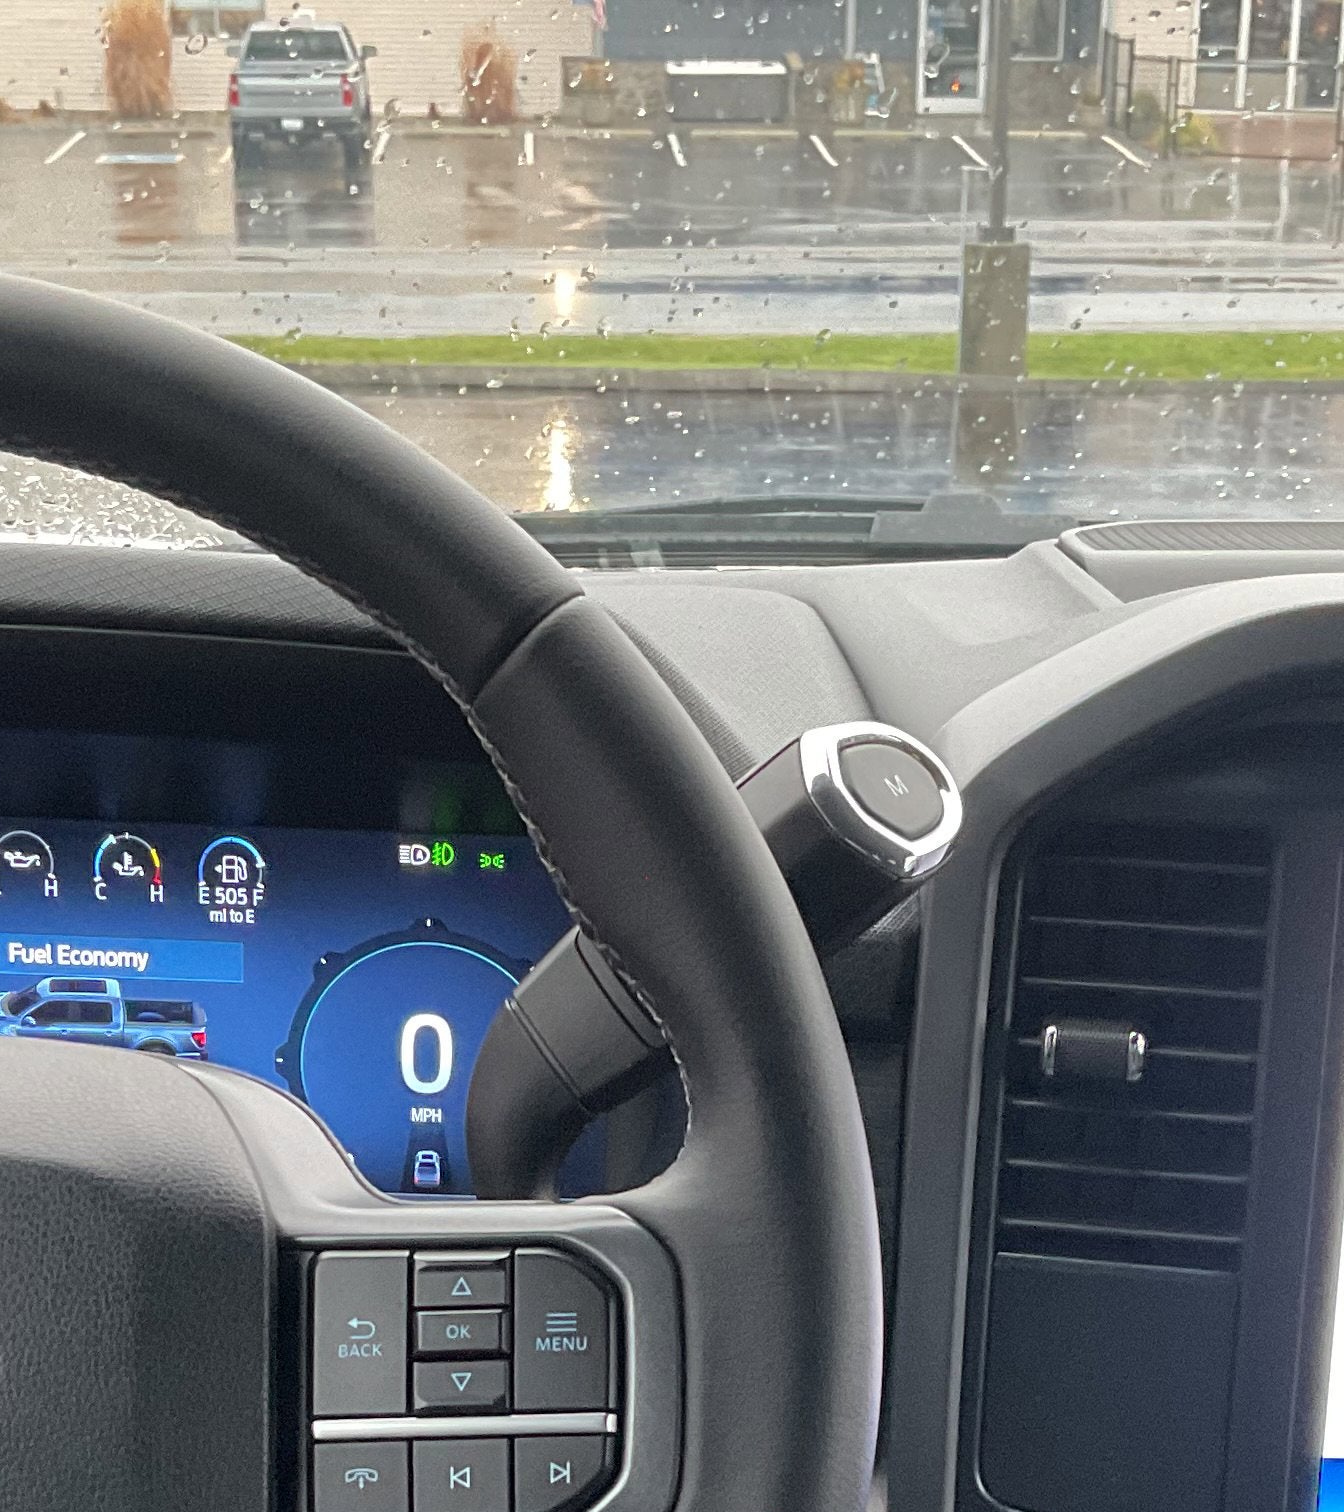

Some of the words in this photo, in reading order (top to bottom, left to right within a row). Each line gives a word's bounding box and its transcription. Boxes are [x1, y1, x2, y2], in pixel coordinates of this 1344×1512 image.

[883, 774, 909, 797] M
[44, 879, 59, 898] H
[94, 882, 108, 901] C
[150, 883, 164, 903] H
[198, 884, 211, 905] E
[214, 886, 248, 906] 505
[252, 887, 265, 907] F
[228, 908, 244, 924] to
[245, 908, 255, 924] E
[8, 942, 53, 965] Fuel
[56, 944, 149, 972] Economy
[400, 1013, 453, 1094] 0
[411, 1107, 442, 1123] MPH
[445, 1324, 471, 1341] OK
[338, 1343, 383, 1359] BACK
[535, 1336, 588, 1352] MENU
